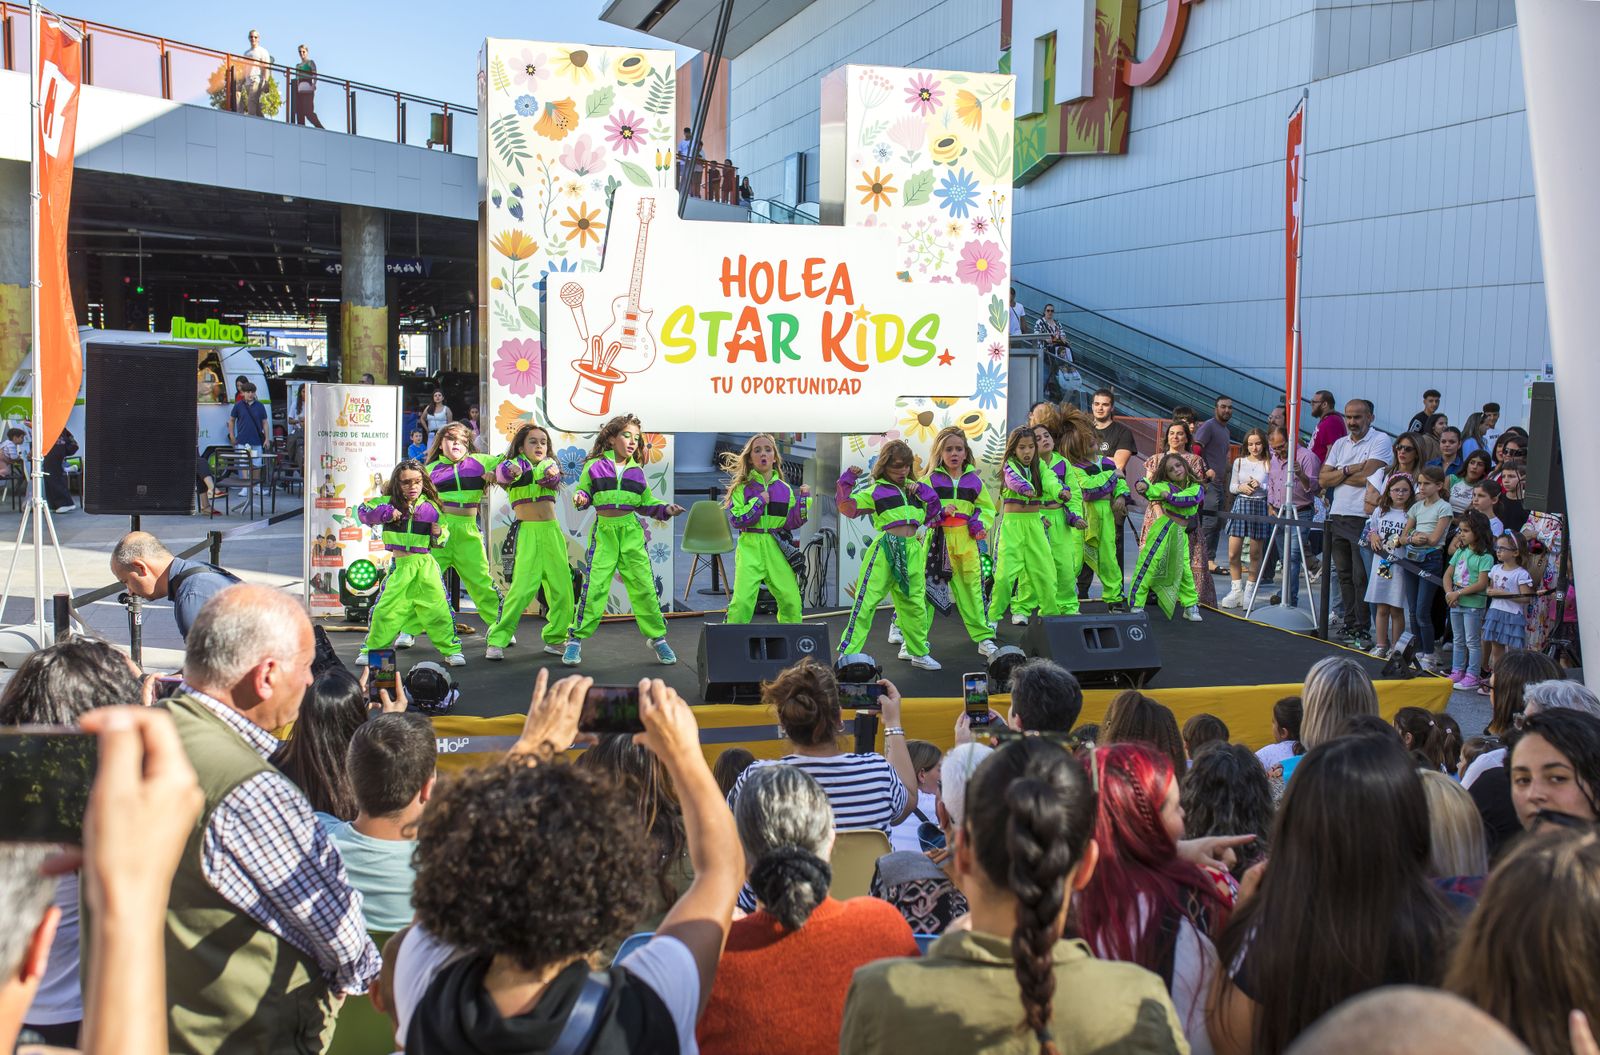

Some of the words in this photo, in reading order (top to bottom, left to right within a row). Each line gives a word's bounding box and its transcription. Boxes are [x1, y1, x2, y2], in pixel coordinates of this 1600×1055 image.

[719, 254, 854, 305] HOLEA
[171, 316, 244, 342] llaollao
[660, 304, 801, 364] STAR
[710, 376, 733, 394] TU
[741, 376, 862, 395] OPORTUNIDAD
[347, 404, 371, 413] STAR
[350, 431, 359, 439] DE
[361, 431, 389, 439] TALENTOS
[1381, 519, 1394, 527] IT'S
